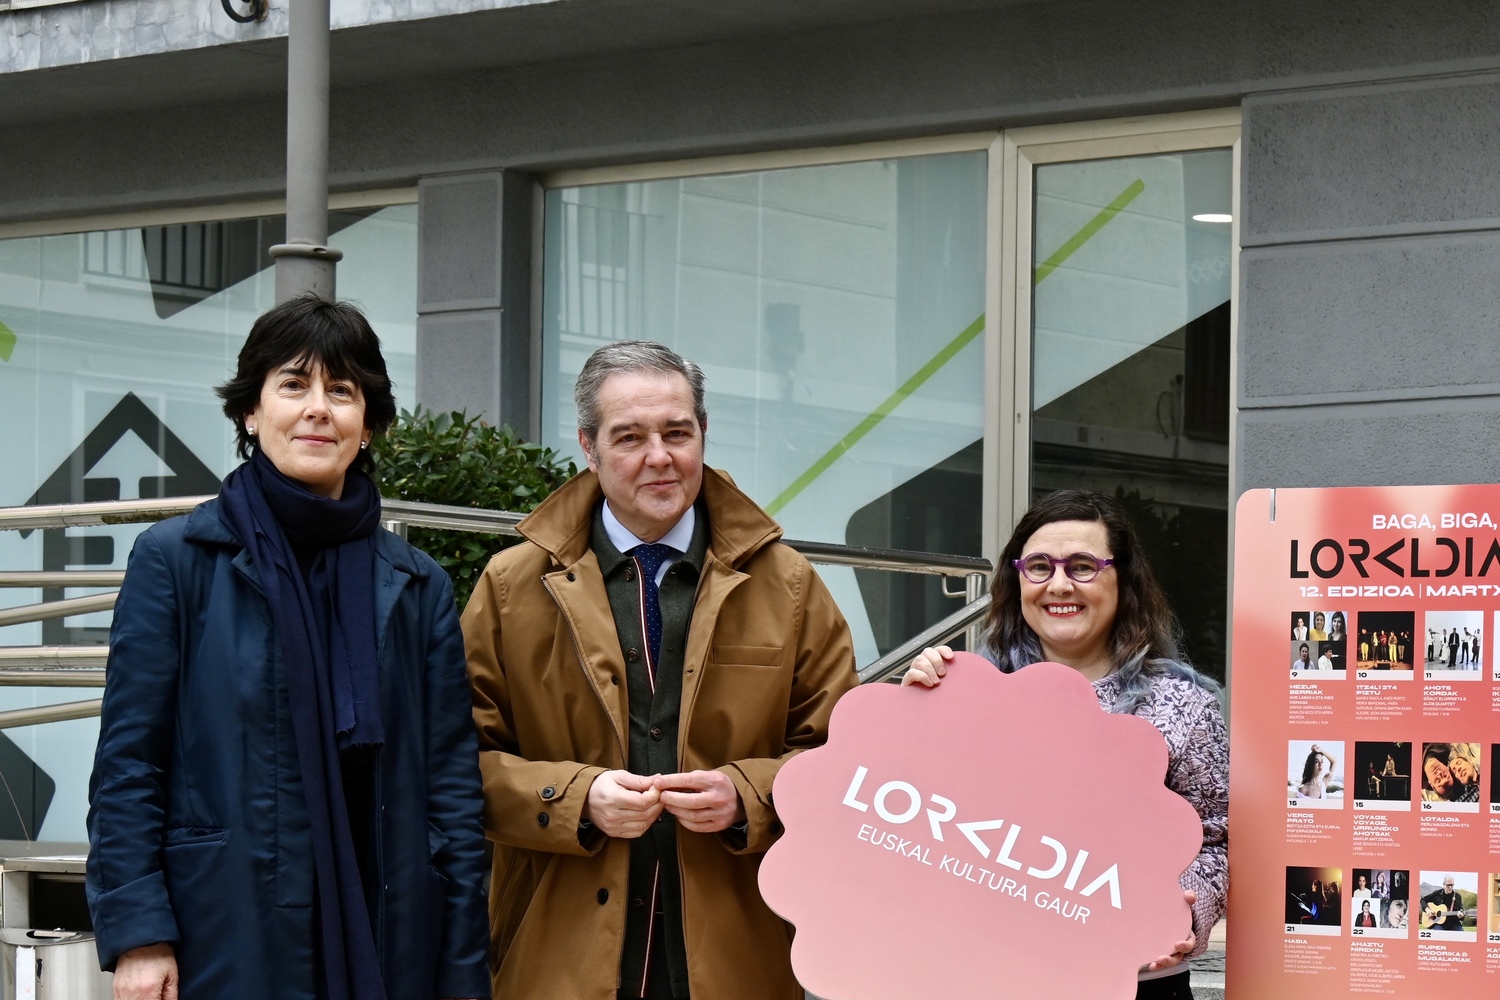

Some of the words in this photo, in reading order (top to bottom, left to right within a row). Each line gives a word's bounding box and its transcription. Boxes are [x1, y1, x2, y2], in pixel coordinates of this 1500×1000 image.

[1372, 514, 1436, 531] BAGA,
[1441, 513, 1498, 530] BIGA,
[1299, 586, 1323, 598] 12.
[1327, 585, 1415, 598] EDIZIOA
[841, 765, 1122, 910] LORALDIA
[857, 823, 933, 866] EUSKAL
[938, 854, 1028, 902] KULTURA
[1034, 891, 1091, 924] GAUR
